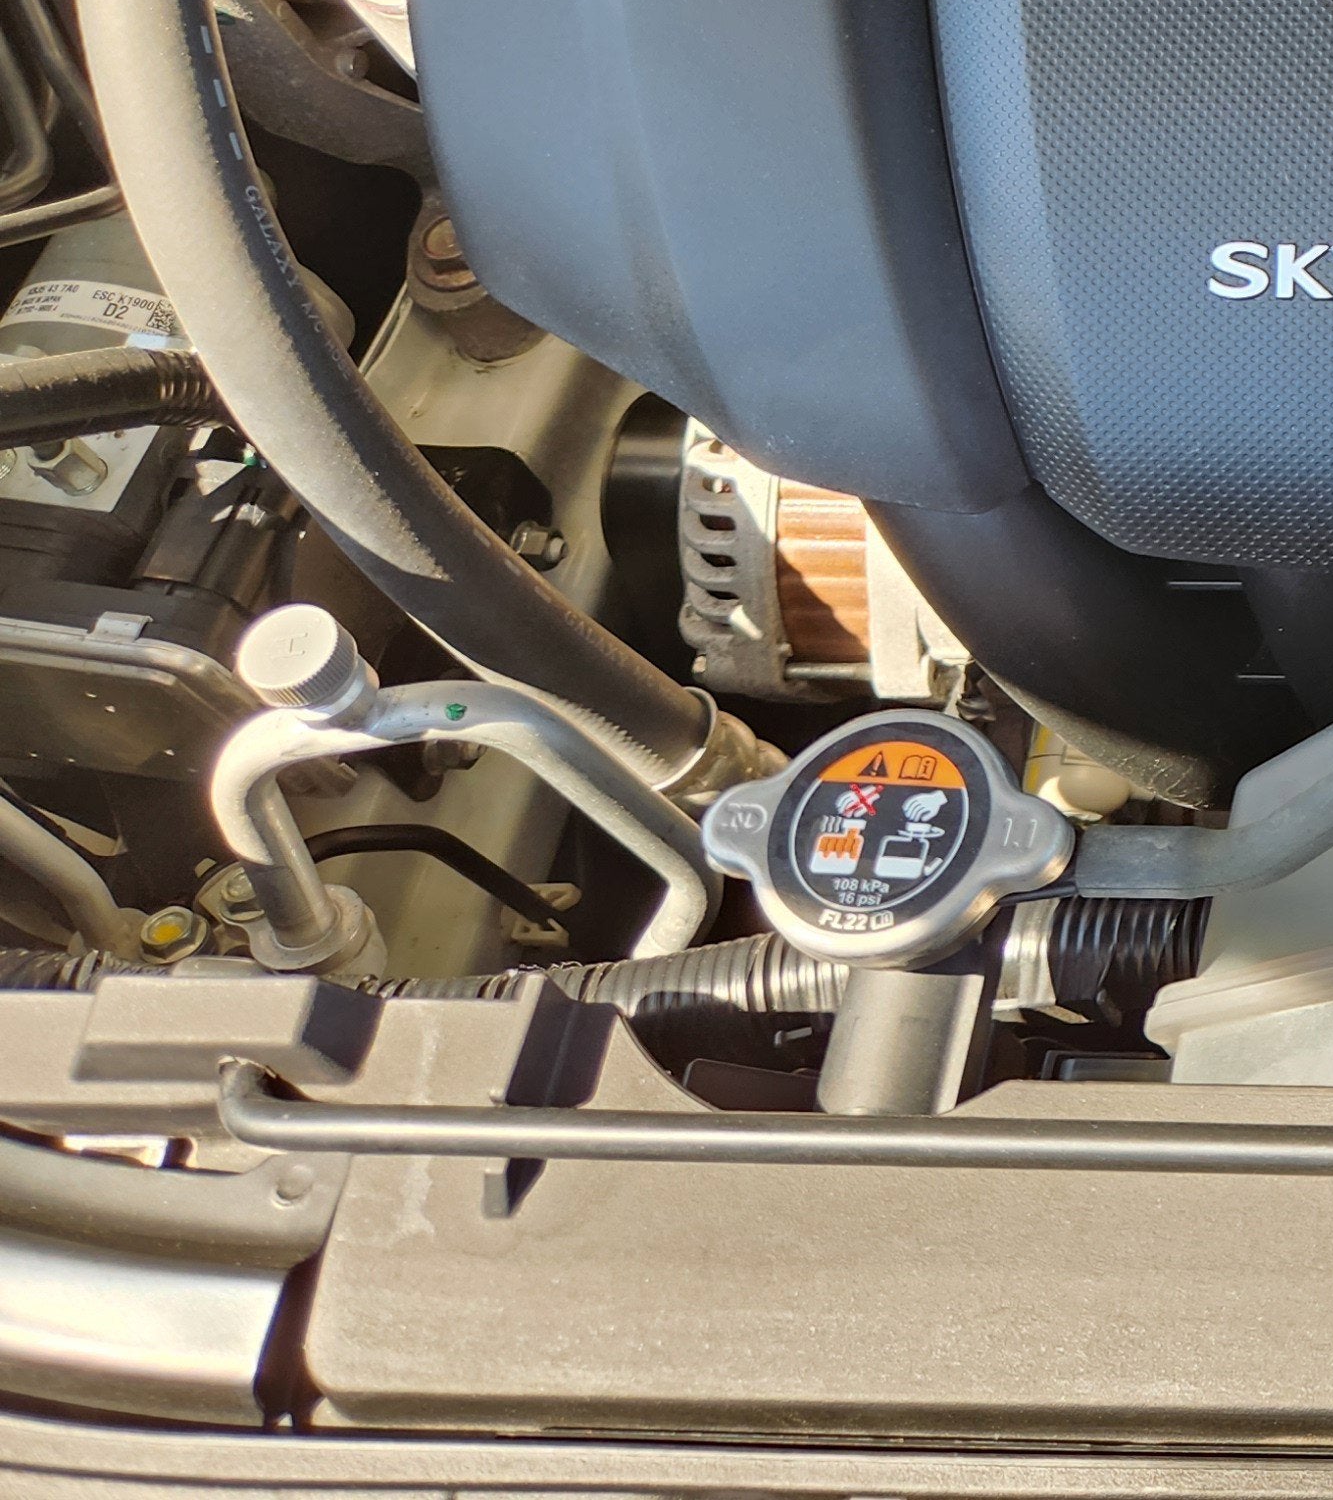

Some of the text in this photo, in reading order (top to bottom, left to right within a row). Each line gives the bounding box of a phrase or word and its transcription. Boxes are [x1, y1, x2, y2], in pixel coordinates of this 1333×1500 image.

[245, 185, 301, 290] GALAXY
[92, 289, 156, 311] ESC K1900
[103, 303, 130, 320] D2
[1003, 817, 1038, 848] 1.1
[832, 877, 890, 894] 108 kPa
[838, 891, 883, 906] 16 psi
[818, 908, 868, 931] FL22
